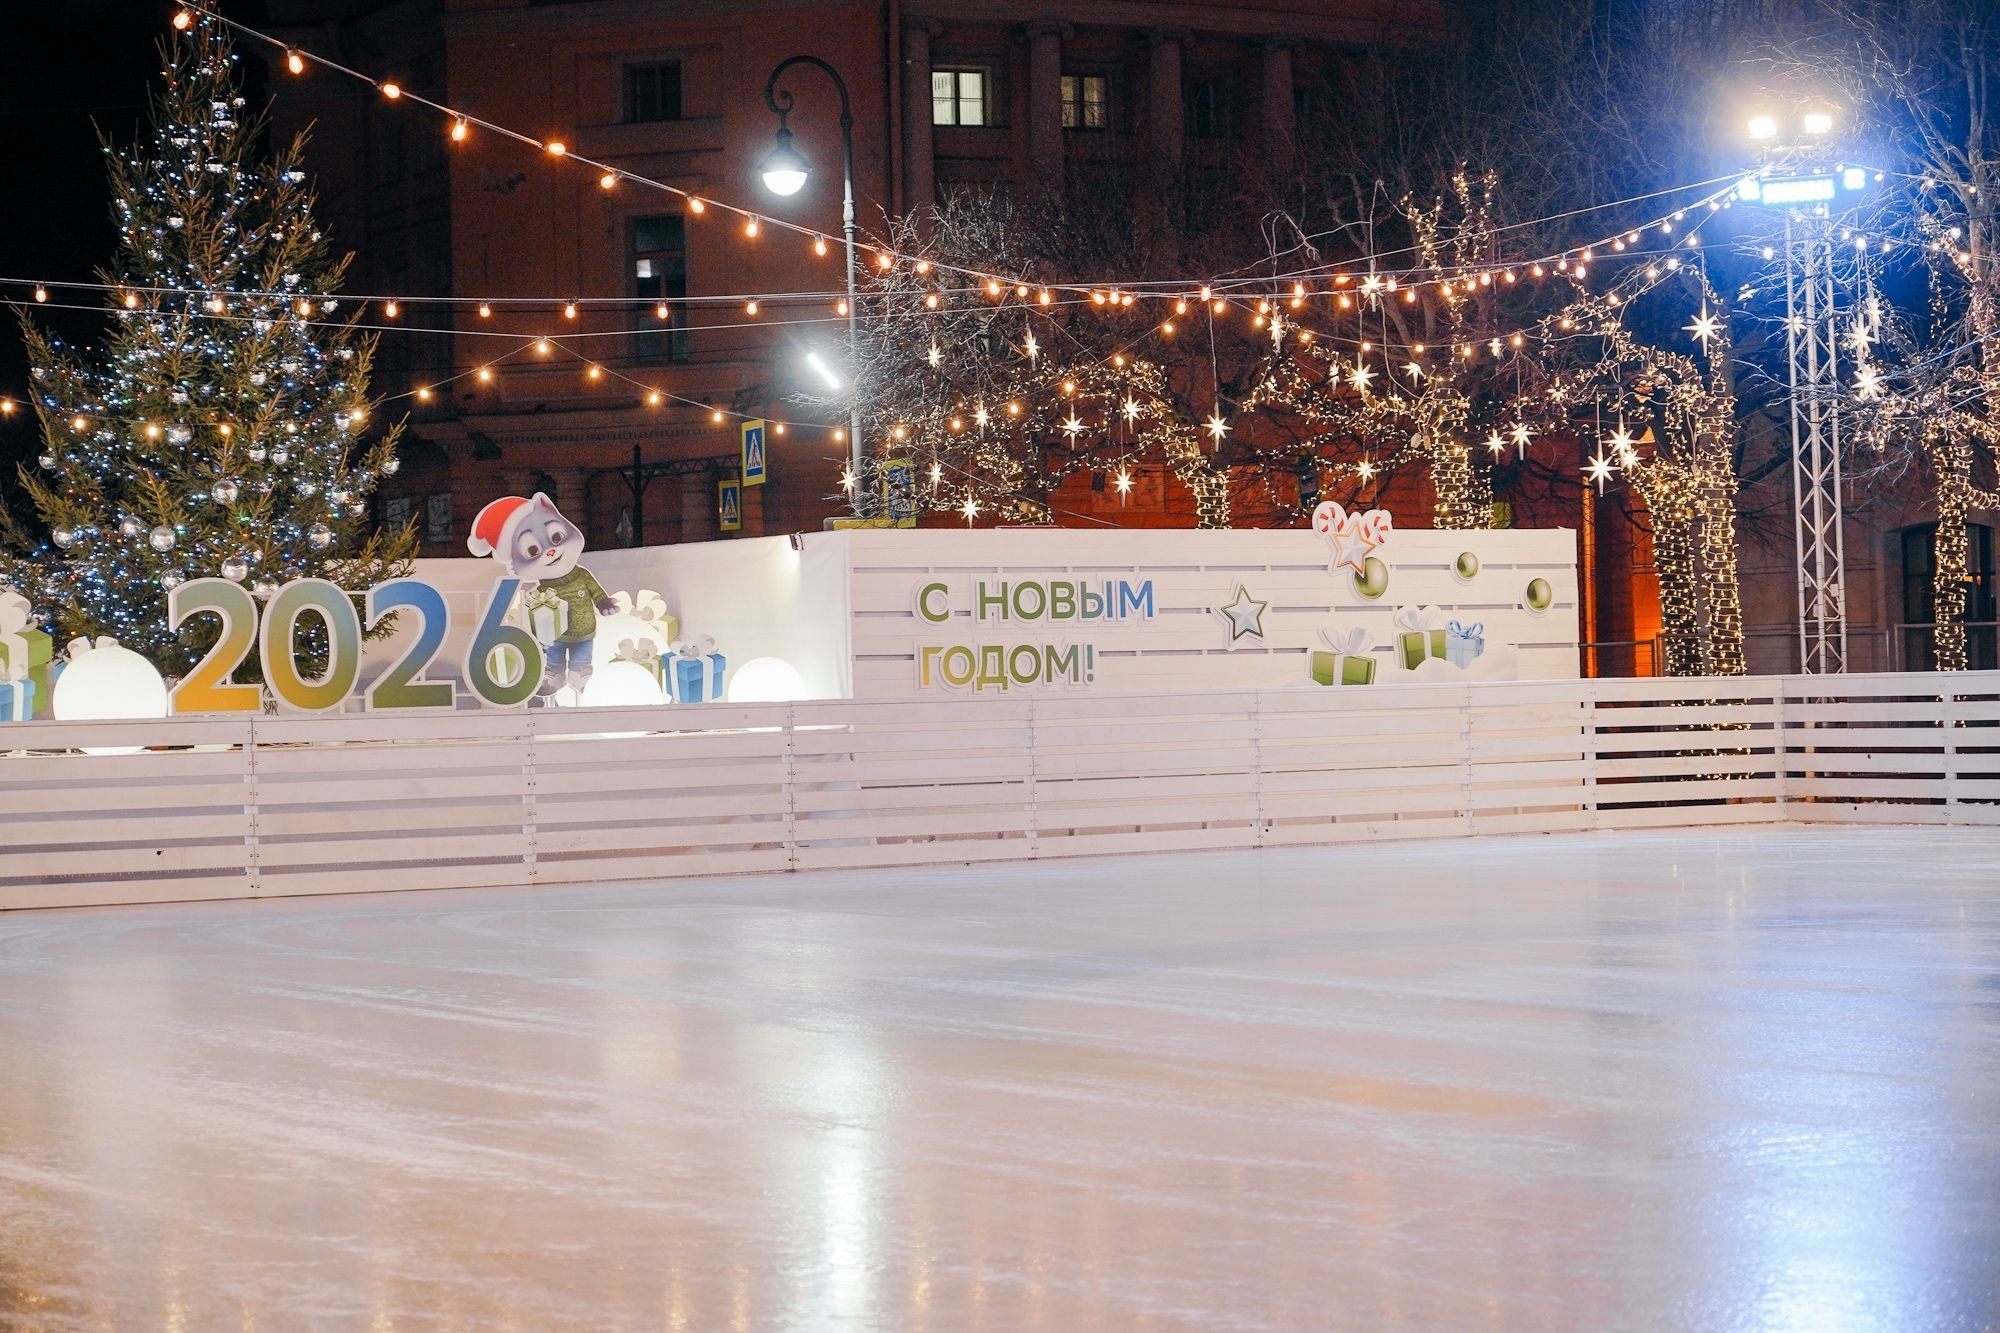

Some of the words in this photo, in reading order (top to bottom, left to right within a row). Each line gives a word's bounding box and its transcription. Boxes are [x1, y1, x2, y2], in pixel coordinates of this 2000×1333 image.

[919, 583, 950, 622] С
[979, 580, 1154, 620] НОВЫМ
[170, 578, 544, 712] 2026
[921, 644, 1094, 691] ГОДОМ!
